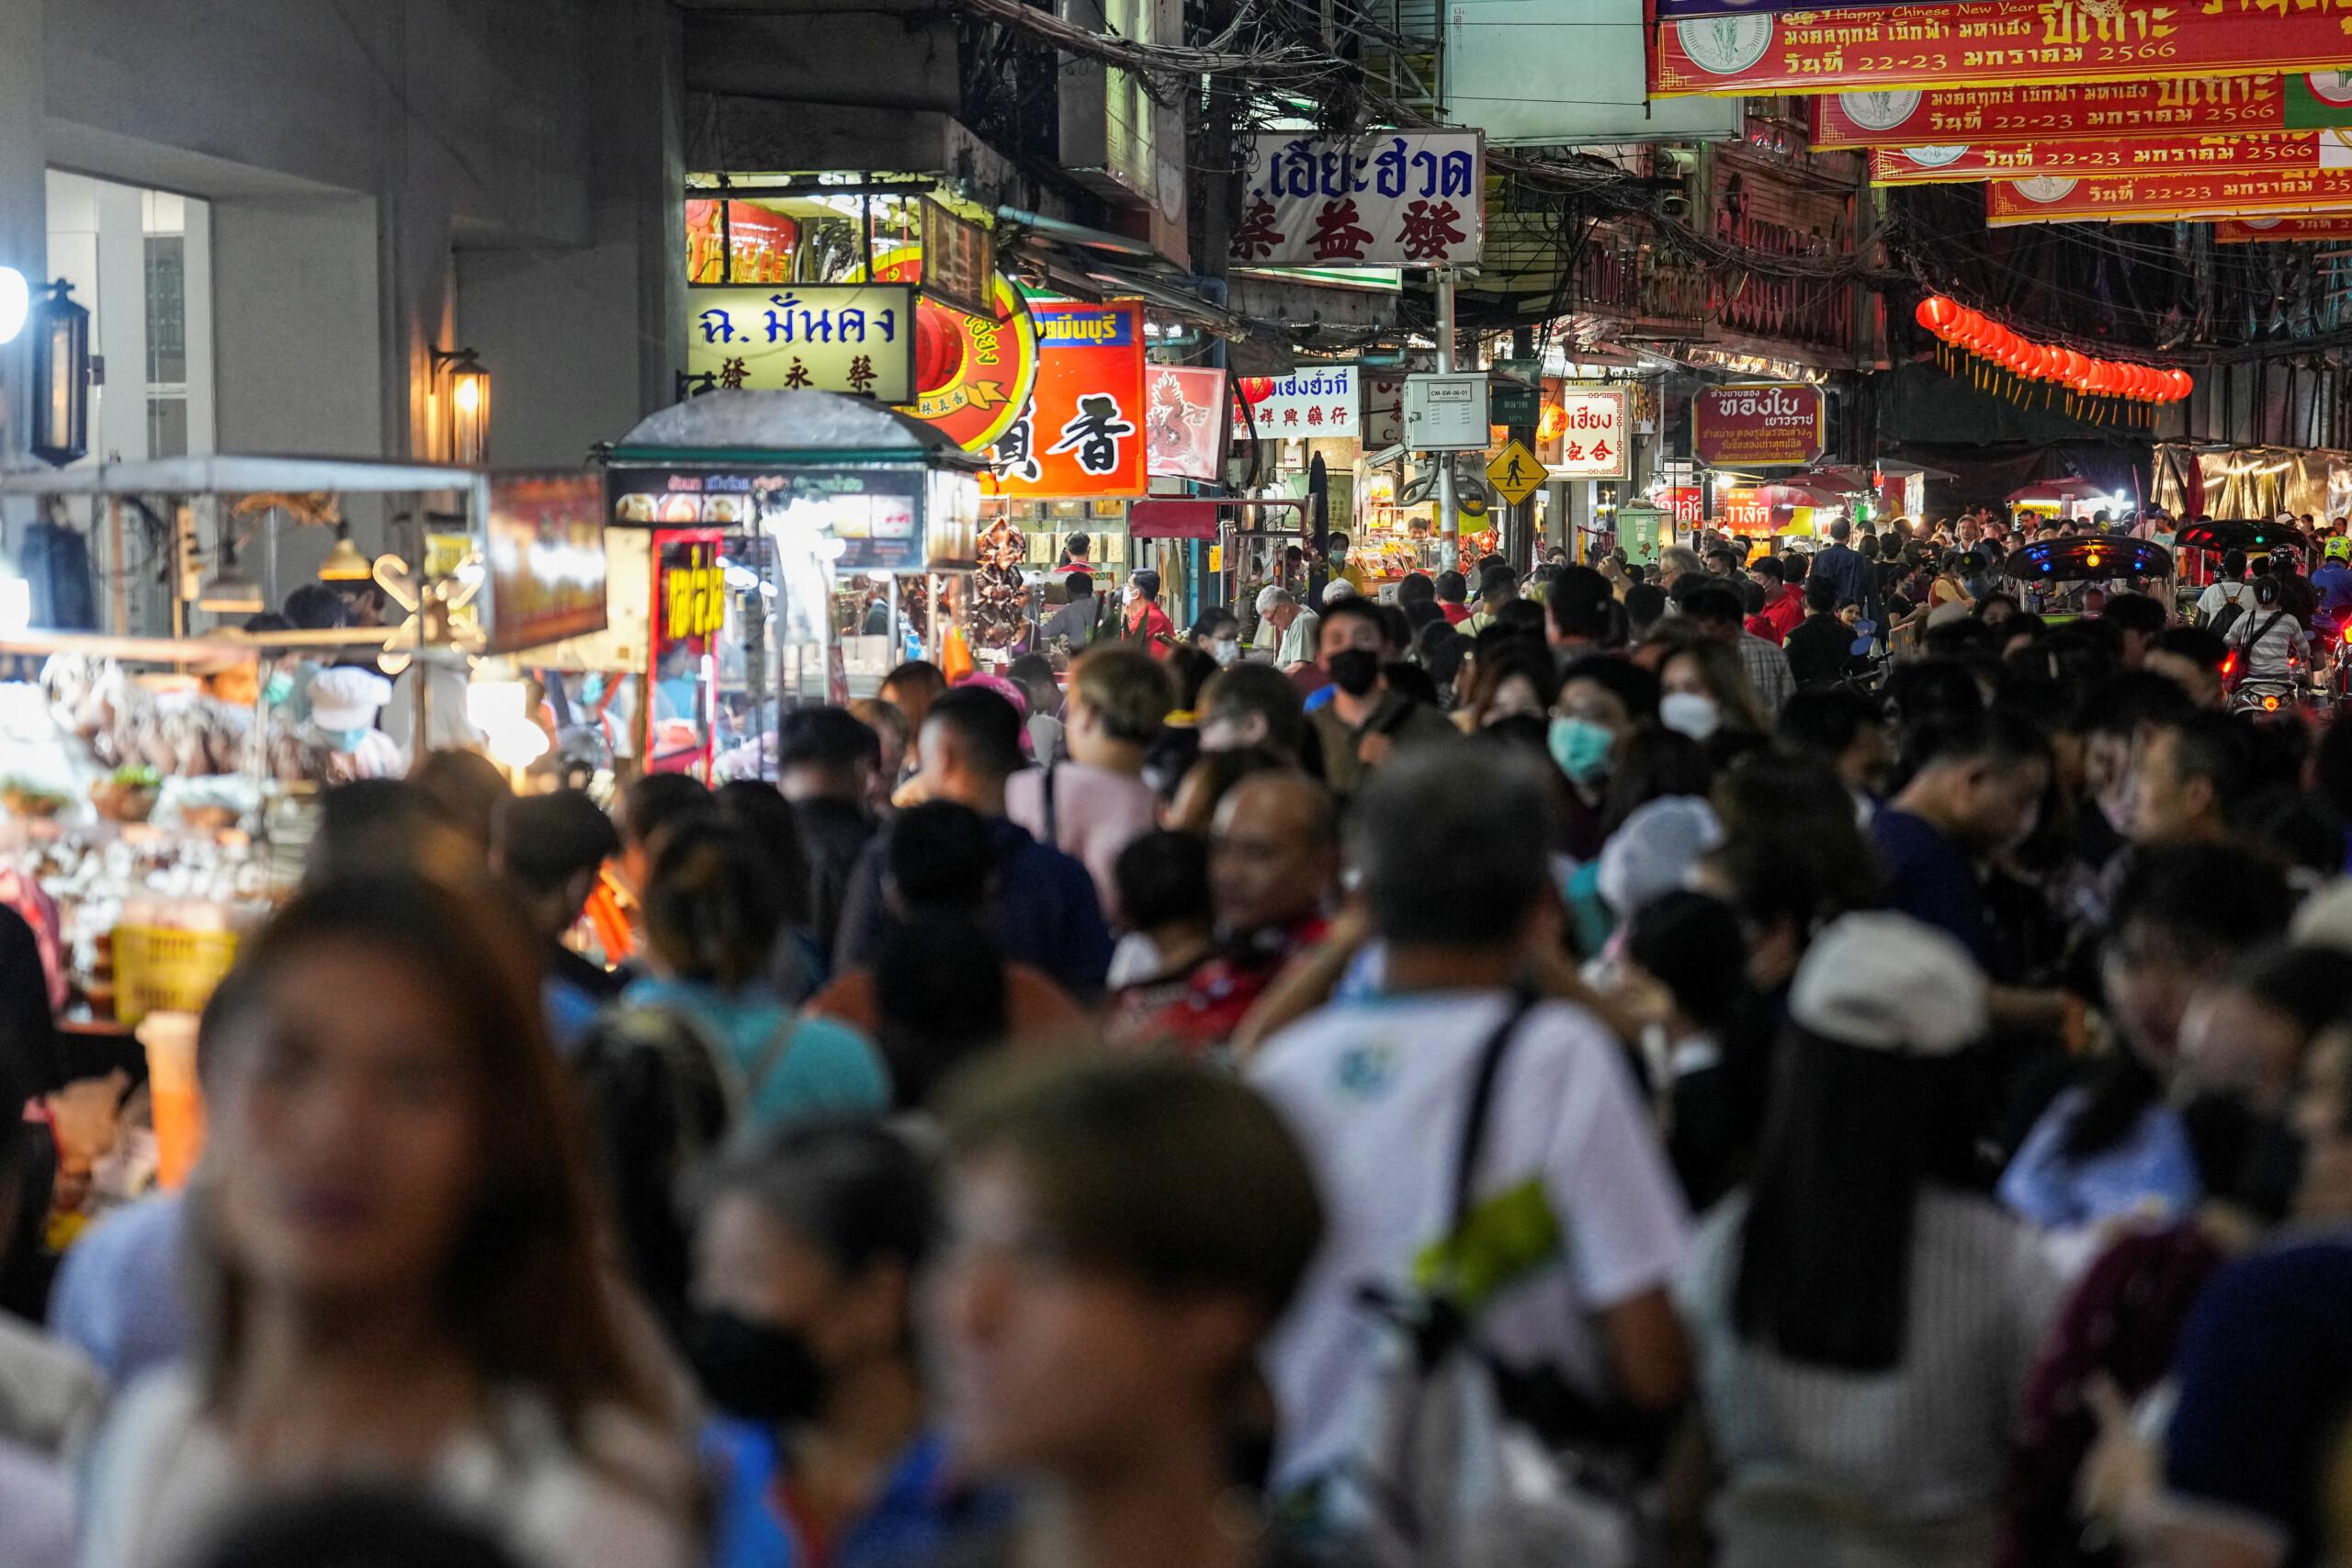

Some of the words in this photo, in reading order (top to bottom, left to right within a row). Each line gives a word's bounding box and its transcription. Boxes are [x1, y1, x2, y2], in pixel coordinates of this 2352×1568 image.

[1838, 10, 1884, 22] Happy
[1893, 6, 1950, 18] Chinese
[1957, 5, 1992, 16] New
[1999, 2, 2035, 15] Year
[1784, 46, 1843, 73] วันที่
[1858, 54, 1948, 72] 22-23
[1963, 47, 2084, 67] มกราคม
[2098, 41, 2177, 62] 2566
[1930, 107, 1982, 131] วันที่
[1993, 114, 2075, 130] 22-23
[2087, 108, 2193, 125] มกราคม
[2206, 105, 2275, 122] 2566
[1984, 142, 2033, 167] วันที่
[2045, 152, 2120, 166] 22-23
[2133, 146, 2234, 163] มกราคม
[2247, 143, 2313, 160] 2566
[2088, 180, 2133, 202] วันที่
[2144, 187, 2211, 200] 22-23
[2223, 180, 2313, 196] มกราคม
[1719, 387, 1799, 417] ทองใบ
[1568, 405, 1612, 430] เฮียง
[1765, 412, 1814, 426] เยาวราช
